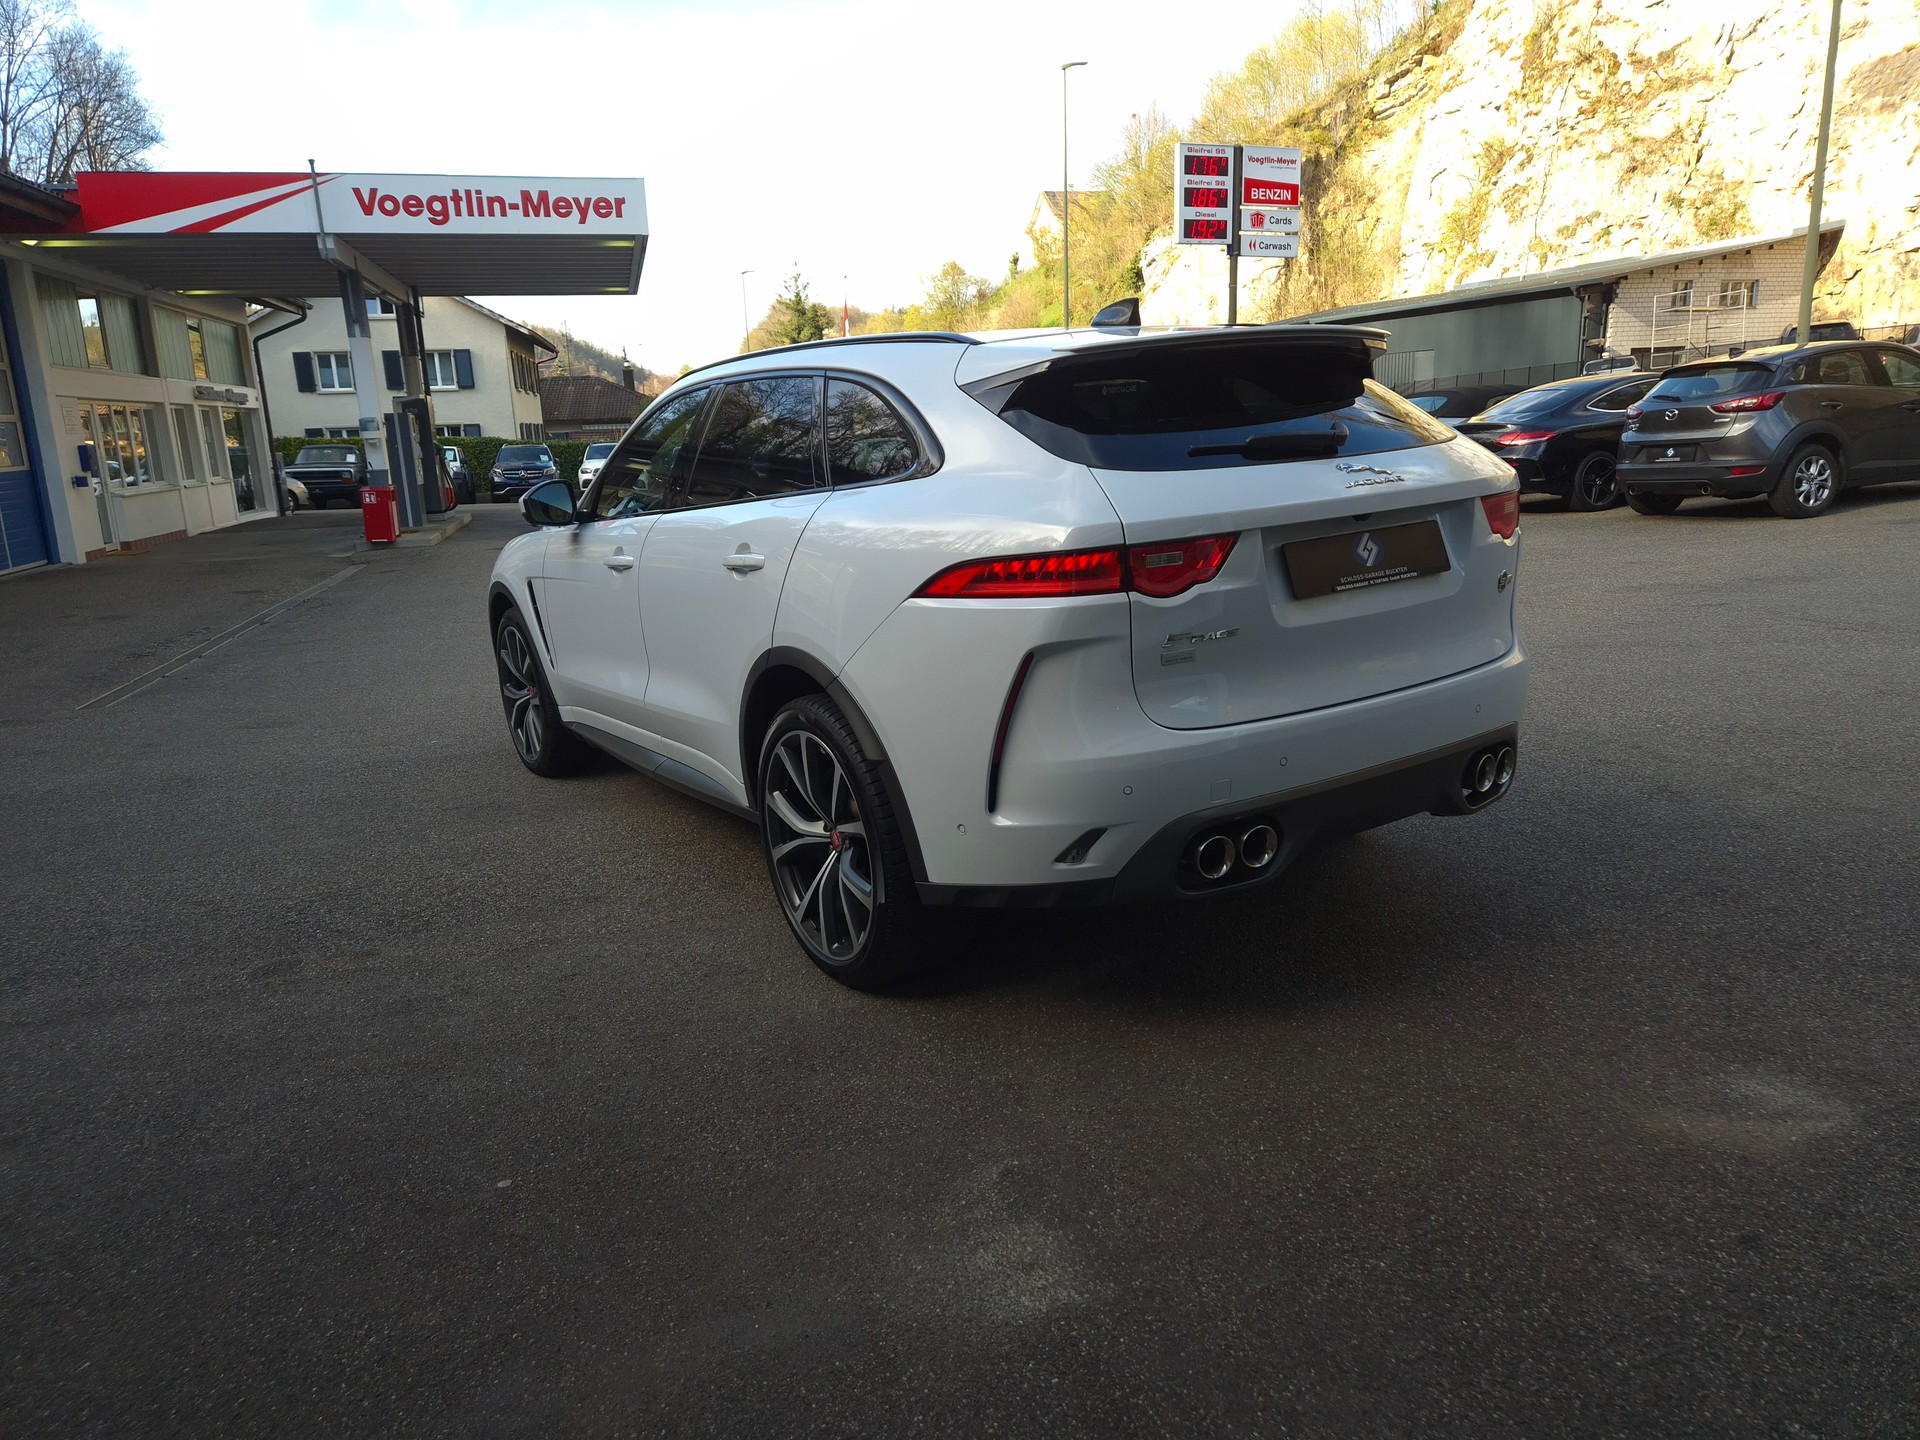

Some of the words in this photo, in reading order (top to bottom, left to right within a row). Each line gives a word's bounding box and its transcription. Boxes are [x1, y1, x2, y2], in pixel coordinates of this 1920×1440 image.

[1247, 155, 1297, 165] Voegtlin-Meyer
[1251, 188, 1291, 201] BENZIN
[351, 187, 626, 226] Voegtlin-Meyer
[1269, 216, 1292, 225] Cards
[1258, 241, 1292, 251] Carwash
[1345, 475, 1405, 488] JAGUAR
[1340, 570, 1385, 583] SCHLOSS-GARAGE
